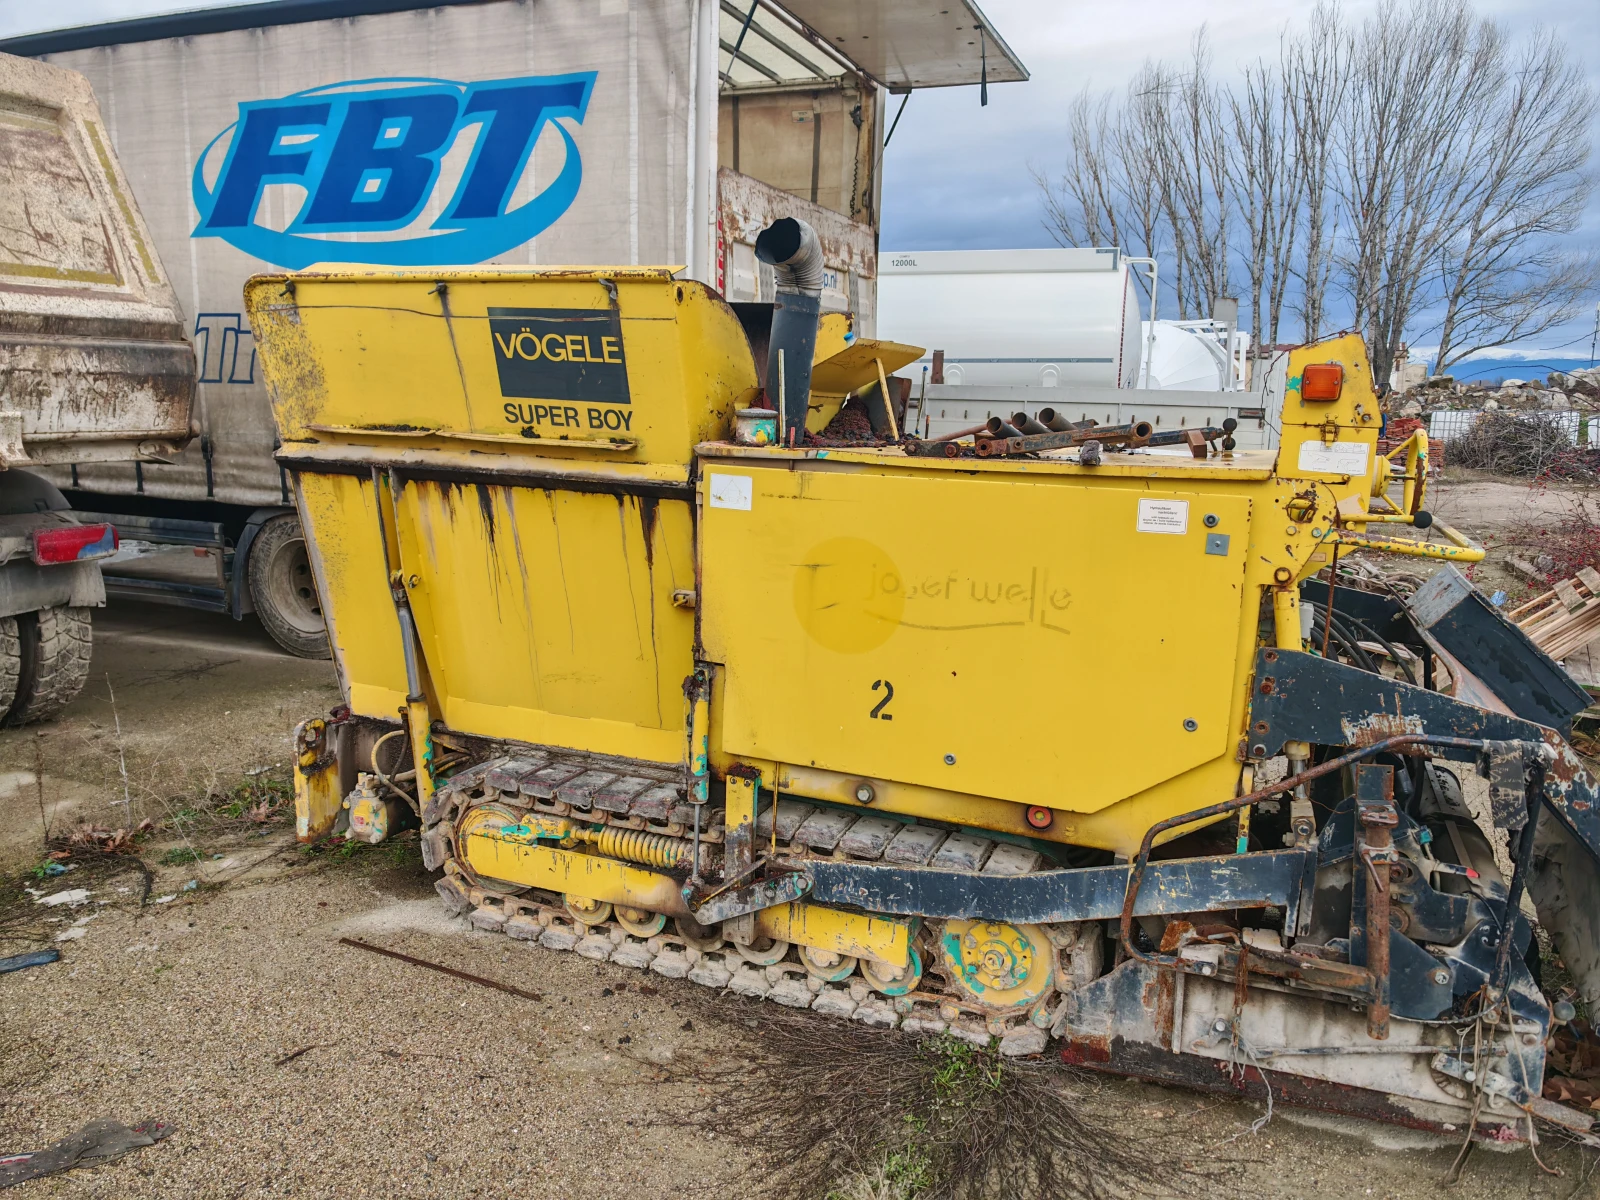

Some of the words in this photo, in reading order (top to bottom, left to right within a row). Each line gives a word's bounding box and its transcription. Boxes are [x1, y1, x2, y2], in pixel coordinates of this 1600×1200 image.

[196, 74, 594, 234] FBT
[891, 259, 918, 267] 12000L
[495, 327, 623, 364] VÖGELE
[503, 403, 581, 428] SUPER
[587, 408, 633, 432] BOY
[870, 679, 894, 721] 2
